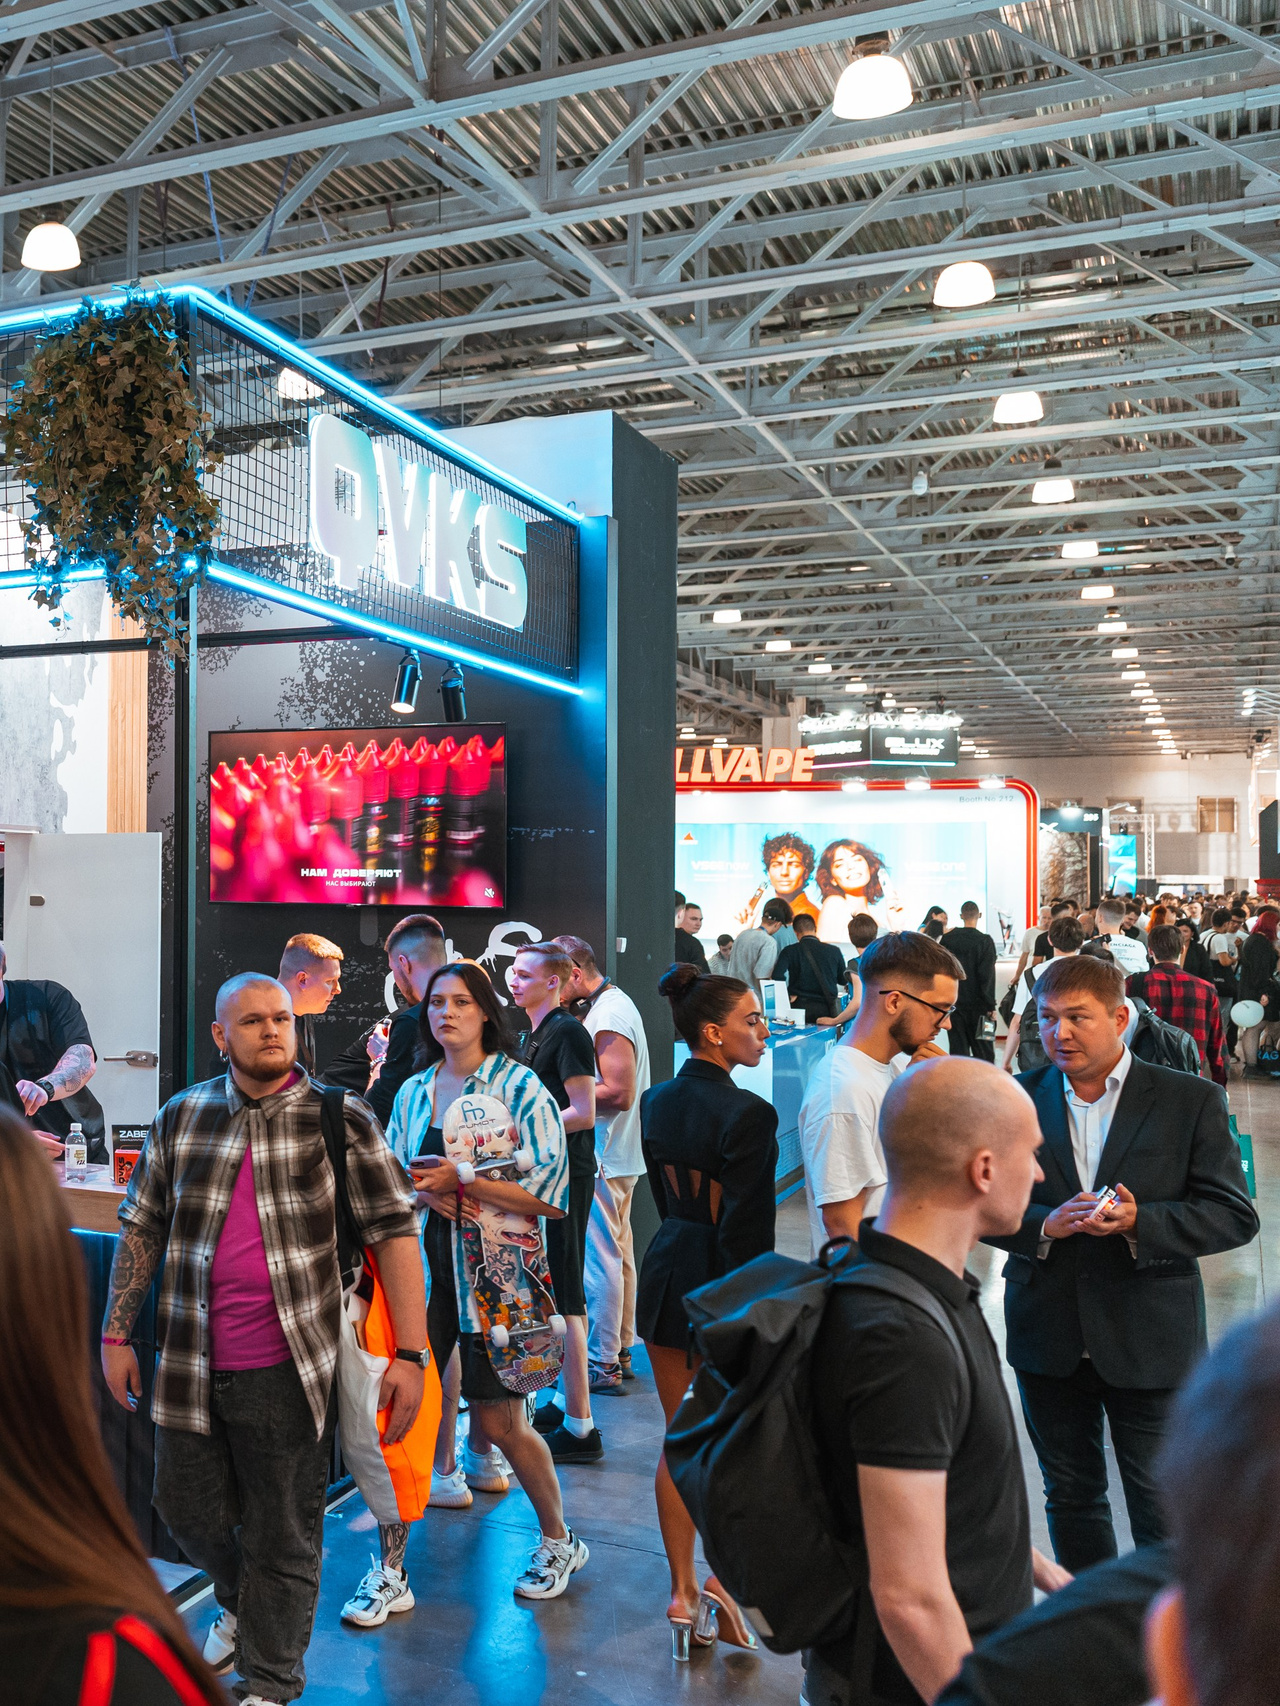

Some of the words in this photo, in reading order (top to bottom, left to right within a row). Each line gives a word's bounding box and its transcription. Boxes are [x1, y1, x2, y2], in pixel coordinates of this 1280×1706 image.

[308, 411, 528, 633] QVKS
[675, 748, 815, 783] LLVAPE
[301, 868, 327, 877] НАМ
[333, 868, 402, 878] ДОВЕРЯЮТ
[119, 1130, 149, 1138] ZABE
